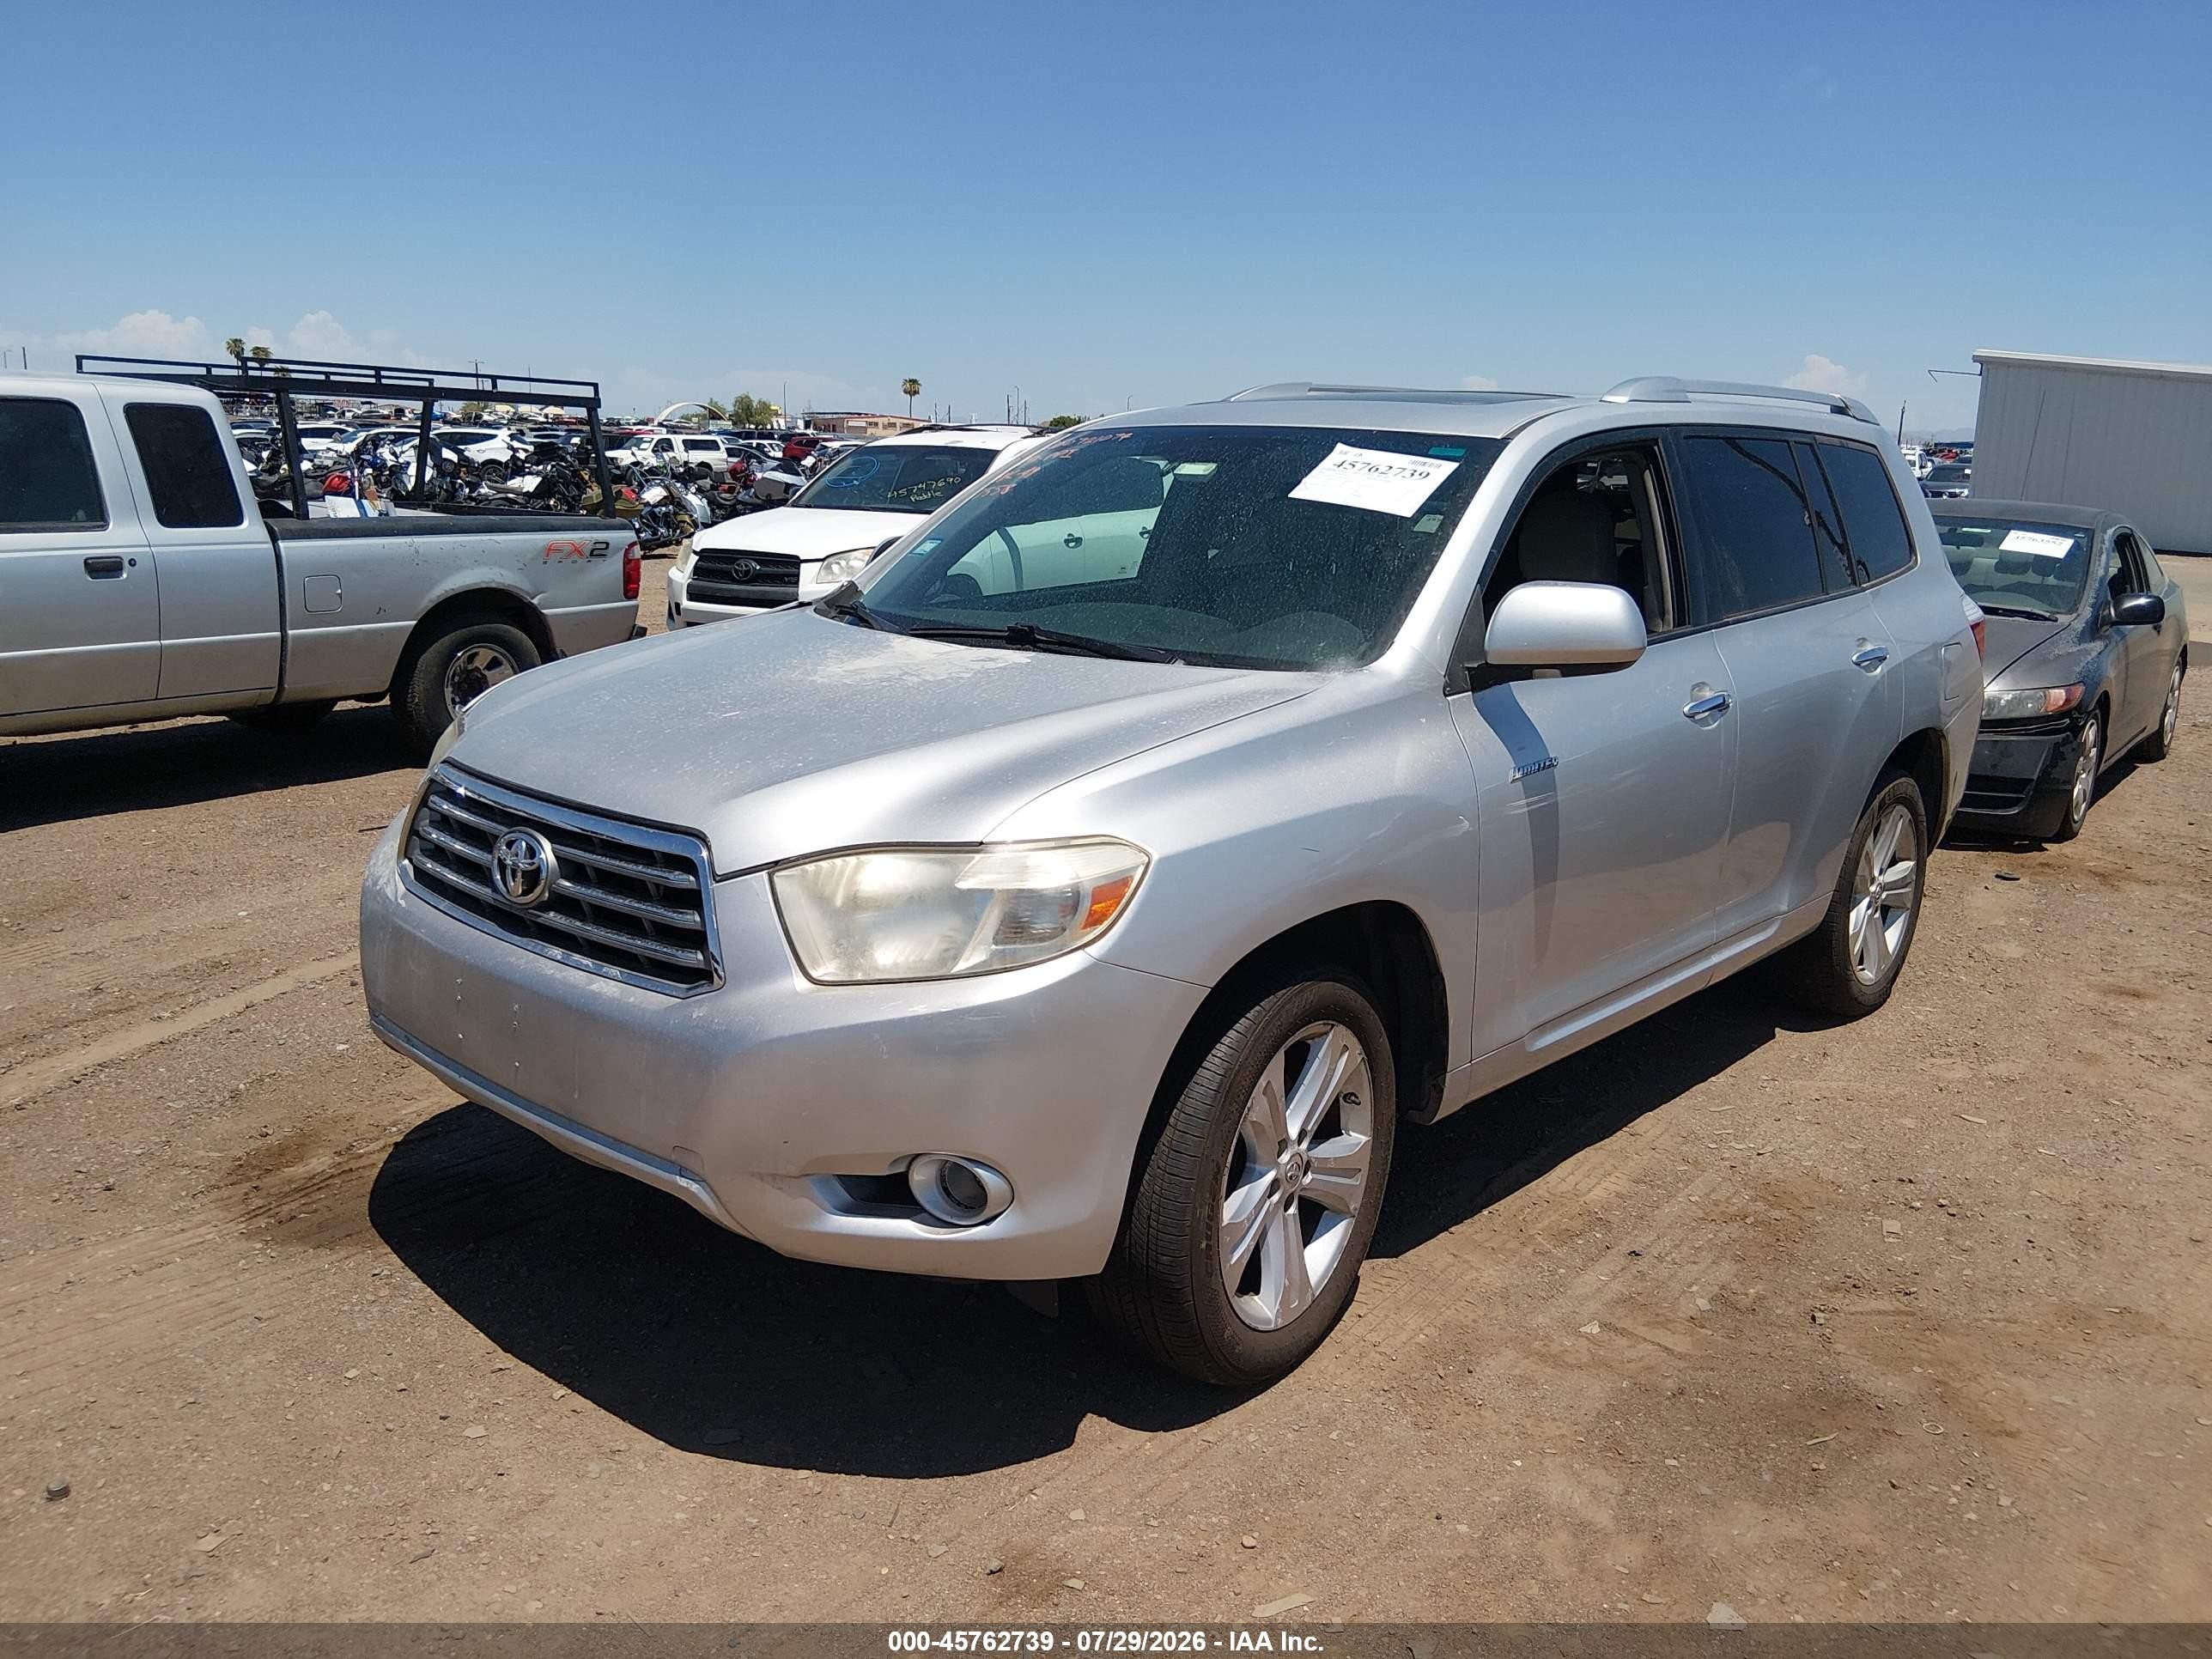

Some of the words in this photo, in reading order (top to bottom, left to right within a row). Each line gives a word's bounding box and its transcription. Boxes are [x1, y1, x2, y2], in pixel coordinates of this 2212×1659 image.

[1333, 459, 1431, 479] 45762739
[887, 477, 962, 499] 45747690
[544, 540, 610, 559] FX2
[1509, 757, 1559, 783] LIMITED
